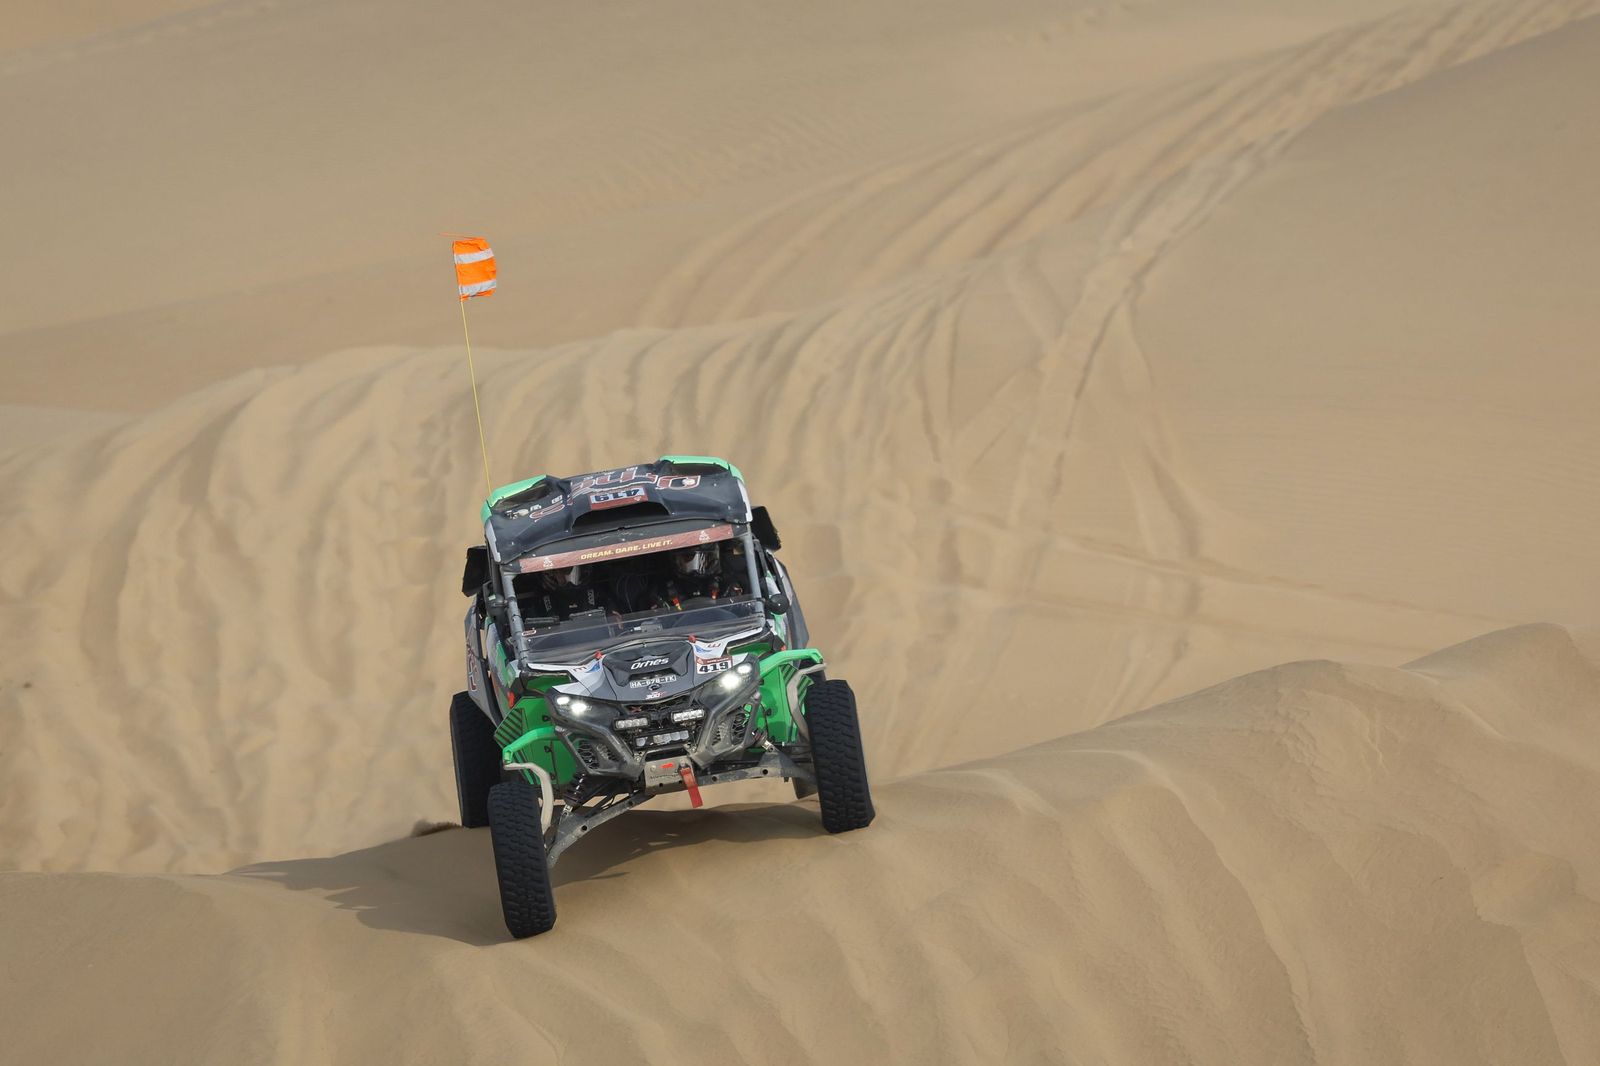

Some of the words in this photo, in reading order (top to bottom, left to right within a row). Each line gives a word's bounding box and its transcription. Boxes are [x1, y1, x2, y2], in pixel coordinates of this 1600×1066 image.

[594, 488, 640, 502] 419
[581, 550, 614, 560] DREAM.
[615, 545, 641, 554] DARE.
[642, 541, 662, 549] LIVE
[699, 661, 729, 672] 419
